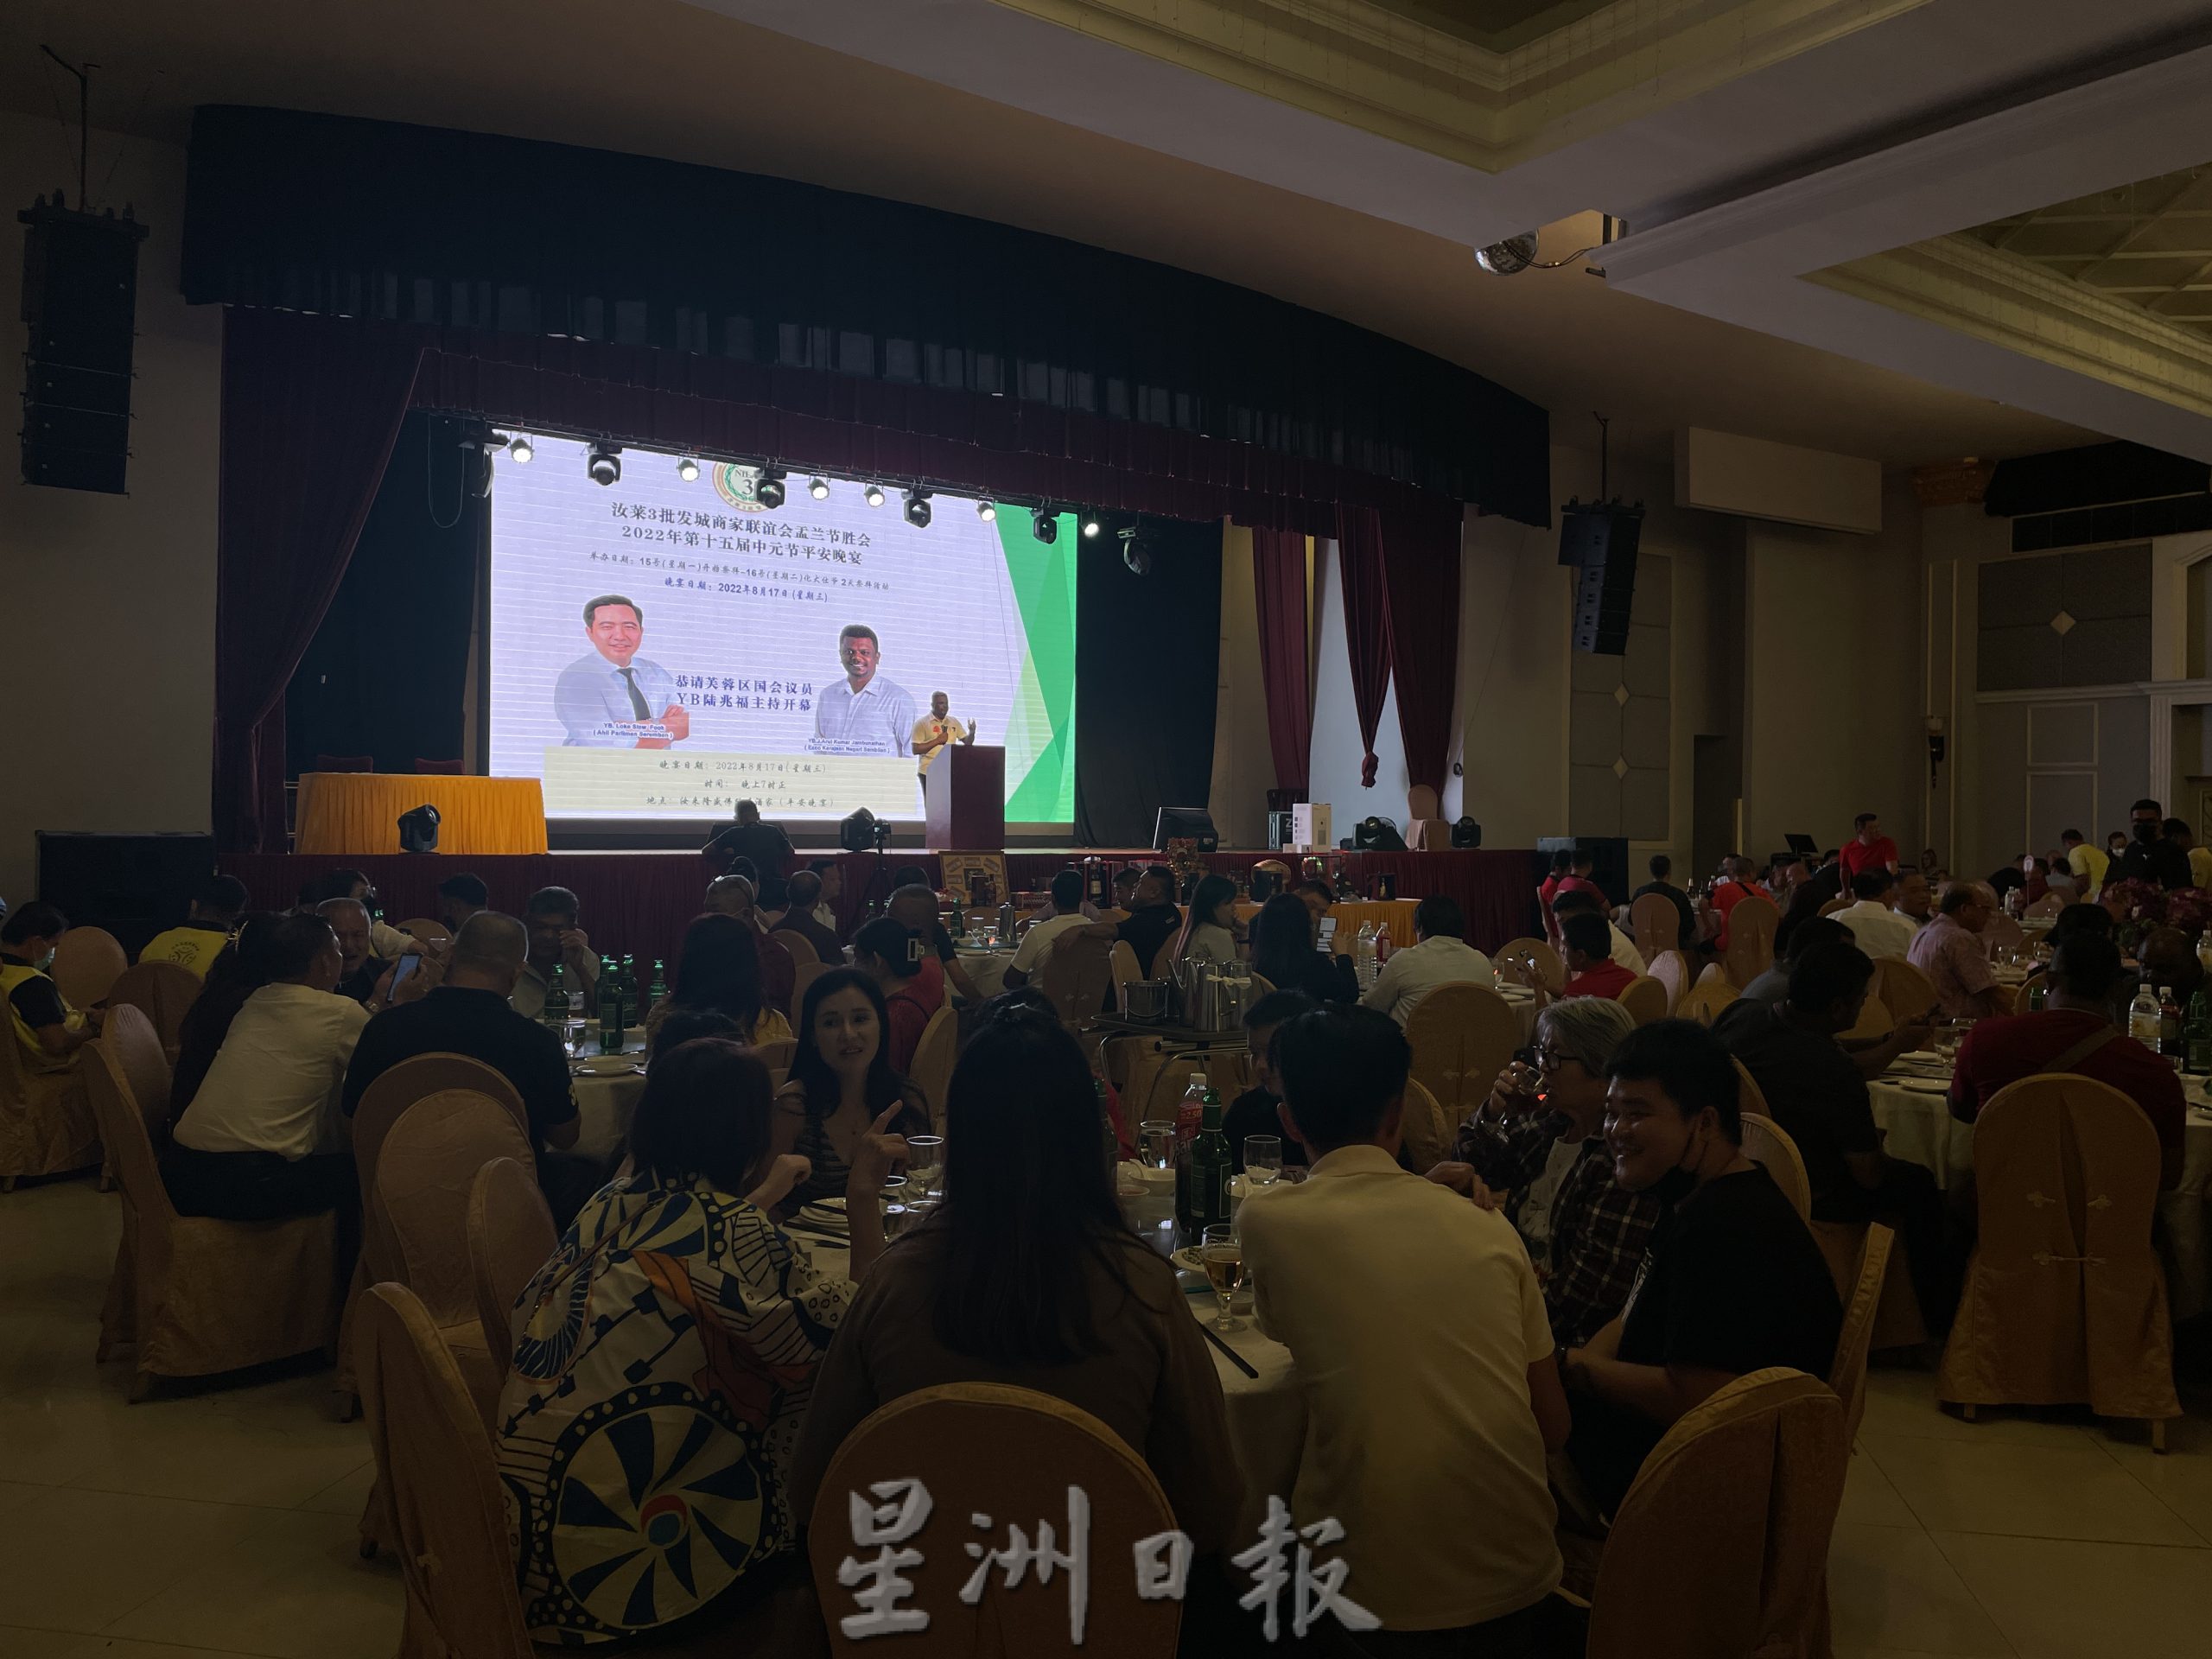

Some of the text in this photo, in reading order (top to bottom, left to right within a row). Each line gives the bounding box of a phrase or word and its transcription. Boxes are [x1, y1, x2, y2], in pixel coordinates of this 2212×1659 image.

[741, 479, 753, 495] 3
[621, 525, 863, 565] 2022年第十五届中元节平安晚宴
[675, 675, 812, 696] 恭请芙蓉区国会议员
